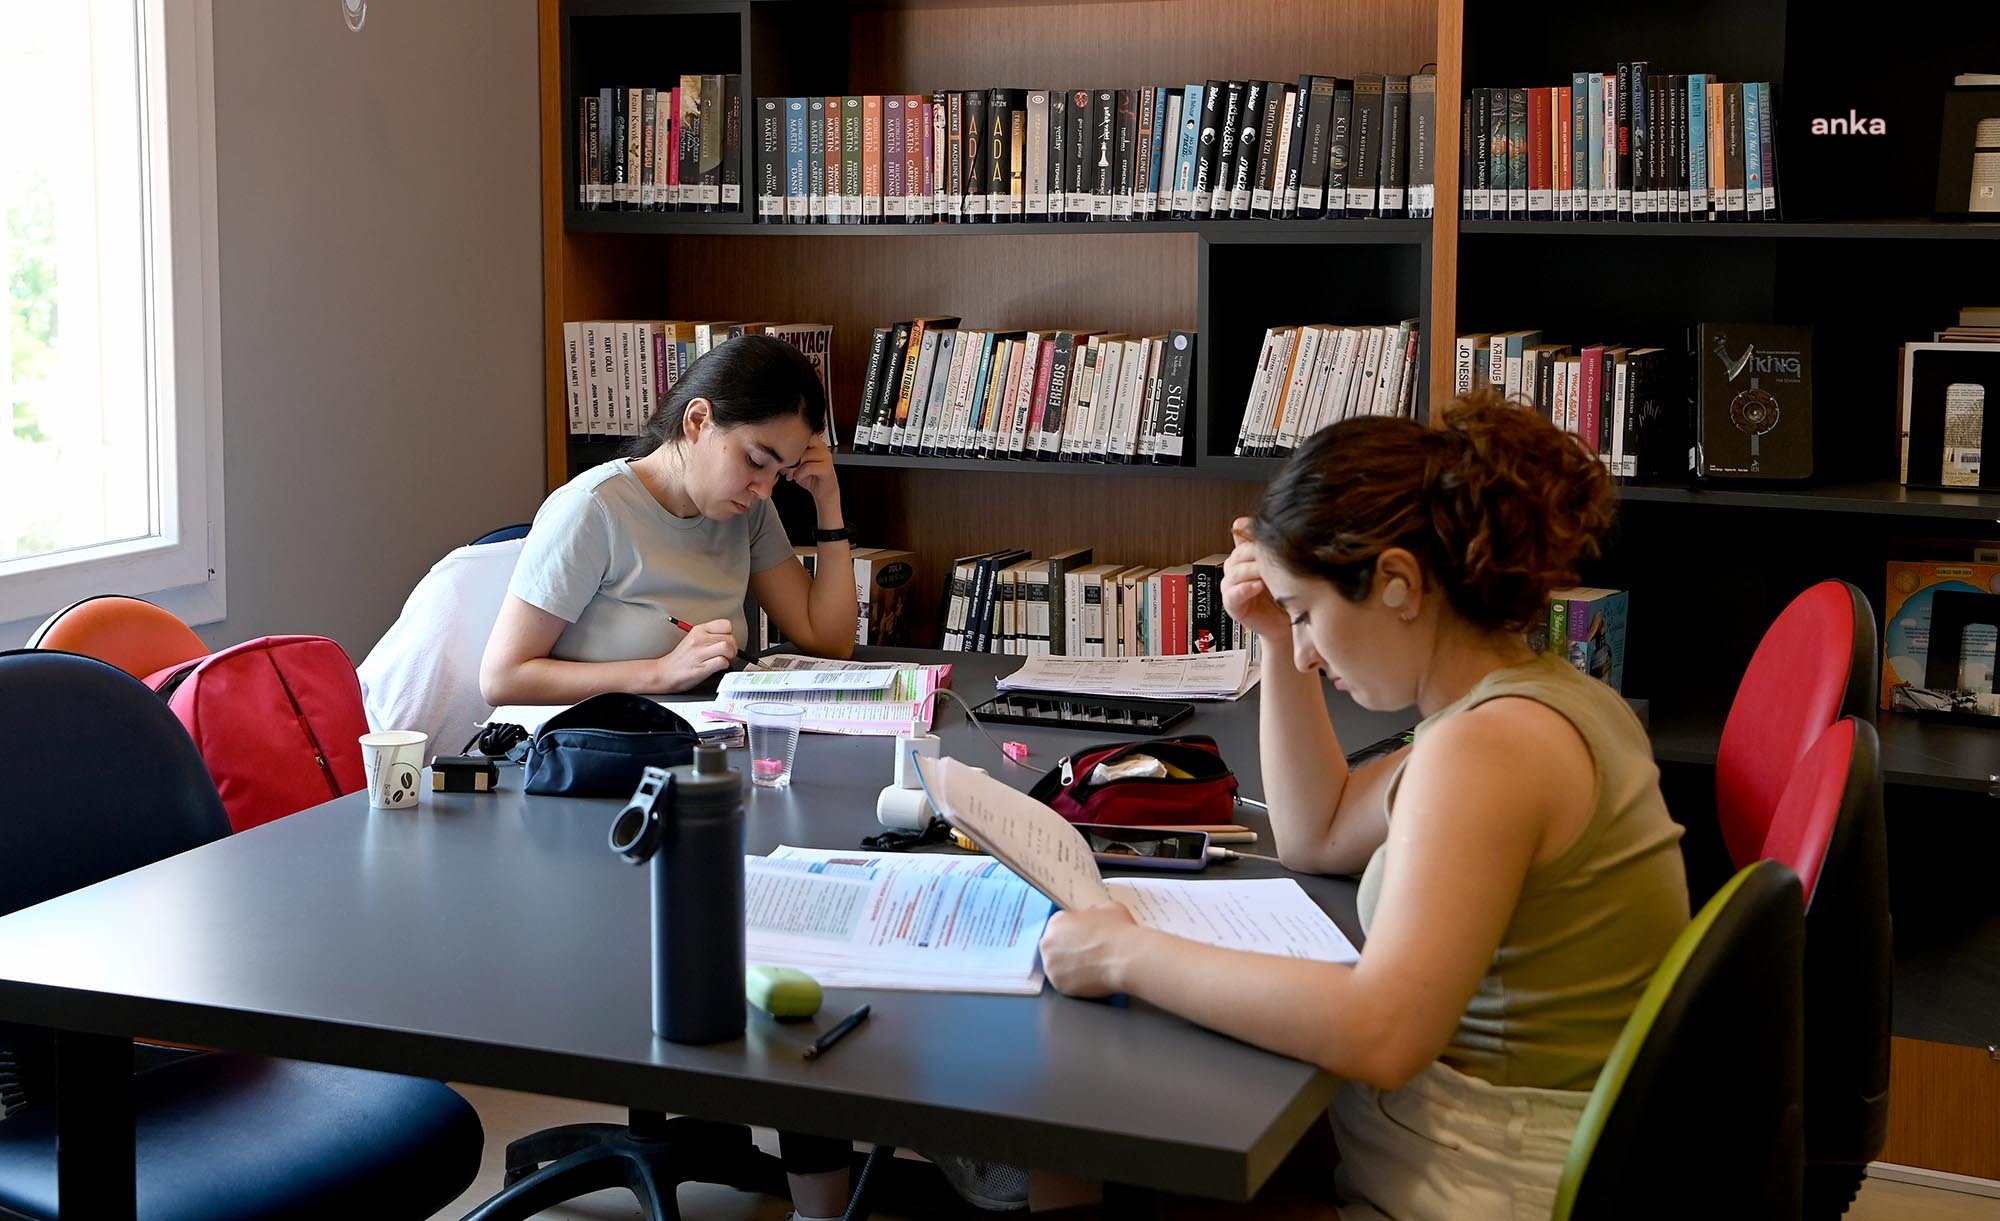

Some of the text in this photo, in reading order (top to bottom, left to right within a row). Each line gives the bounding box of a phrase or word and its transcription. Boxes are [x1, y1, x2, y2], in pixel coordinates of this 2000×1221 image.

[632, 115, 640, 140] Kwok
[992, 116, 1002, 182] ADA
[668, 344, 676, 362] FANG
[1302, 336, 1312, 358] STEFAN
[1459, 344, 1470, 358] JO
[883, 366, 895, 404] HAWKSMOOR
[1049, 363, 1066, 406] EREBOS
[1163, 384, 1184, 436] SÜRÜ
[1197, 573, 1208, 619] GRANGÉ
